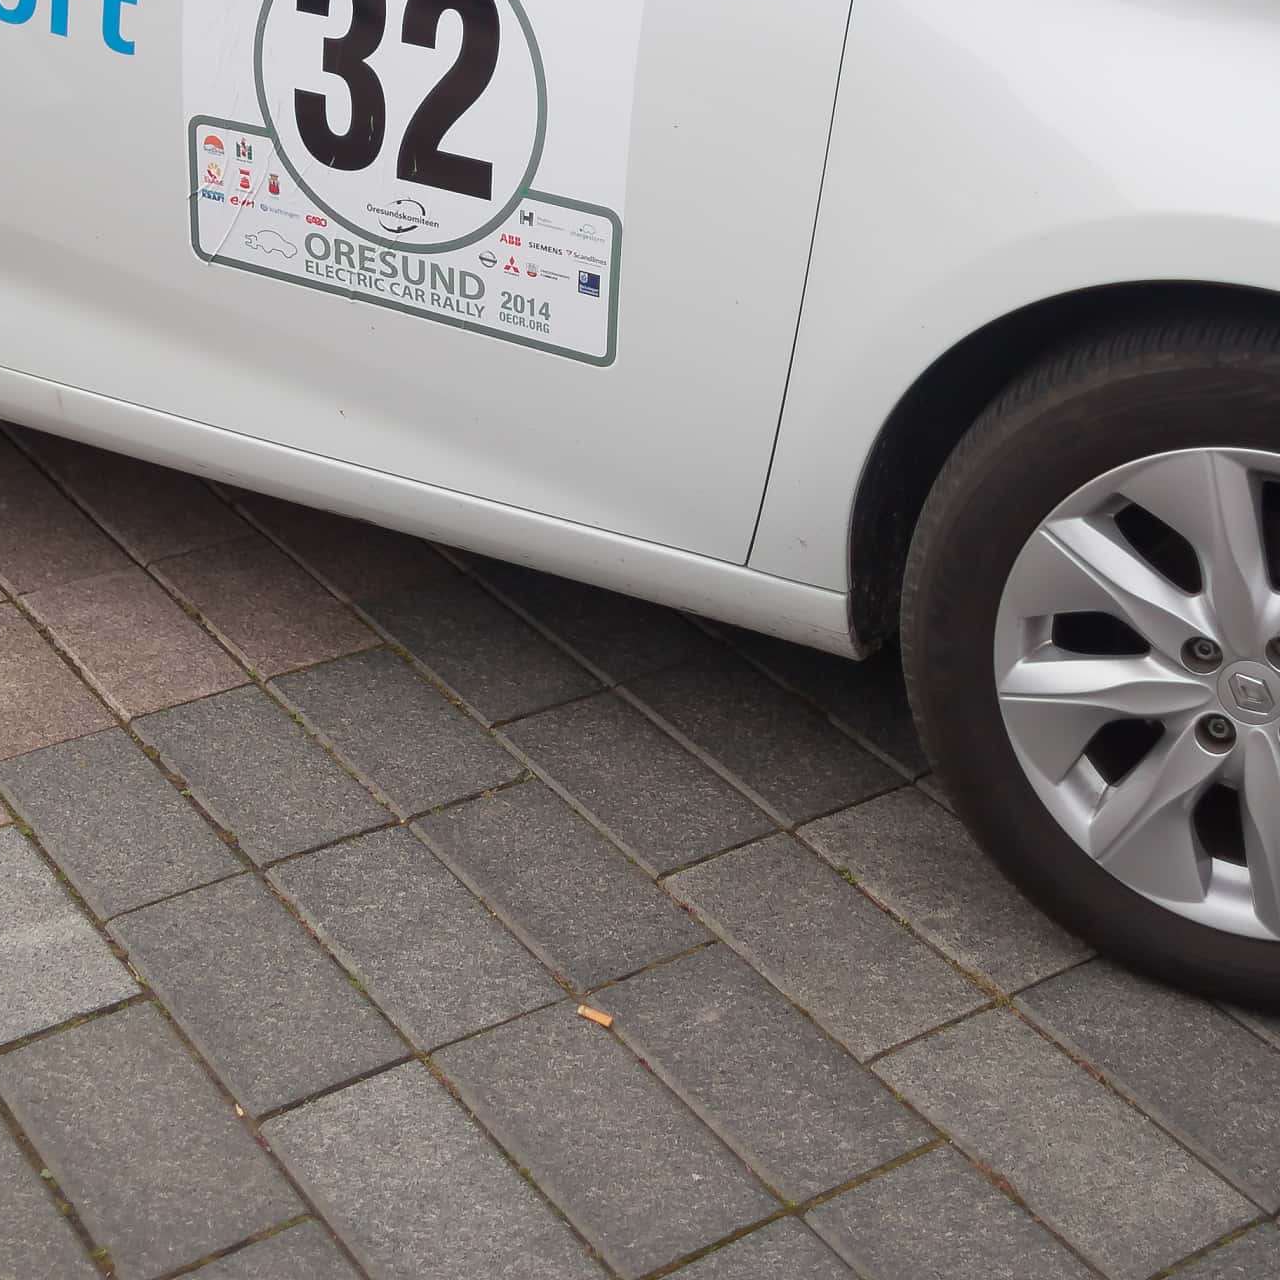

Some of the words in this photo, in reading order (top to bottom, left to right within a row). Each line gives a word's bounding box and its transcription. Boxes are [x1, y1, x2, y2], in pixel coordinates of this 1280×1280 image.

[499, 233, 522, 247] ABB
[528, 241, 563, 256] SIEMENS
[304, 232, 486, 300] ORESUND
[304, 260, 386, 292] ELECTRIC
[390, 282, 426, 303] CAR
[430, 294, 486, 319] RALLY
[500, 291, 551, 320] 2014
[499, 311, 550, 334] OECR.ORG
